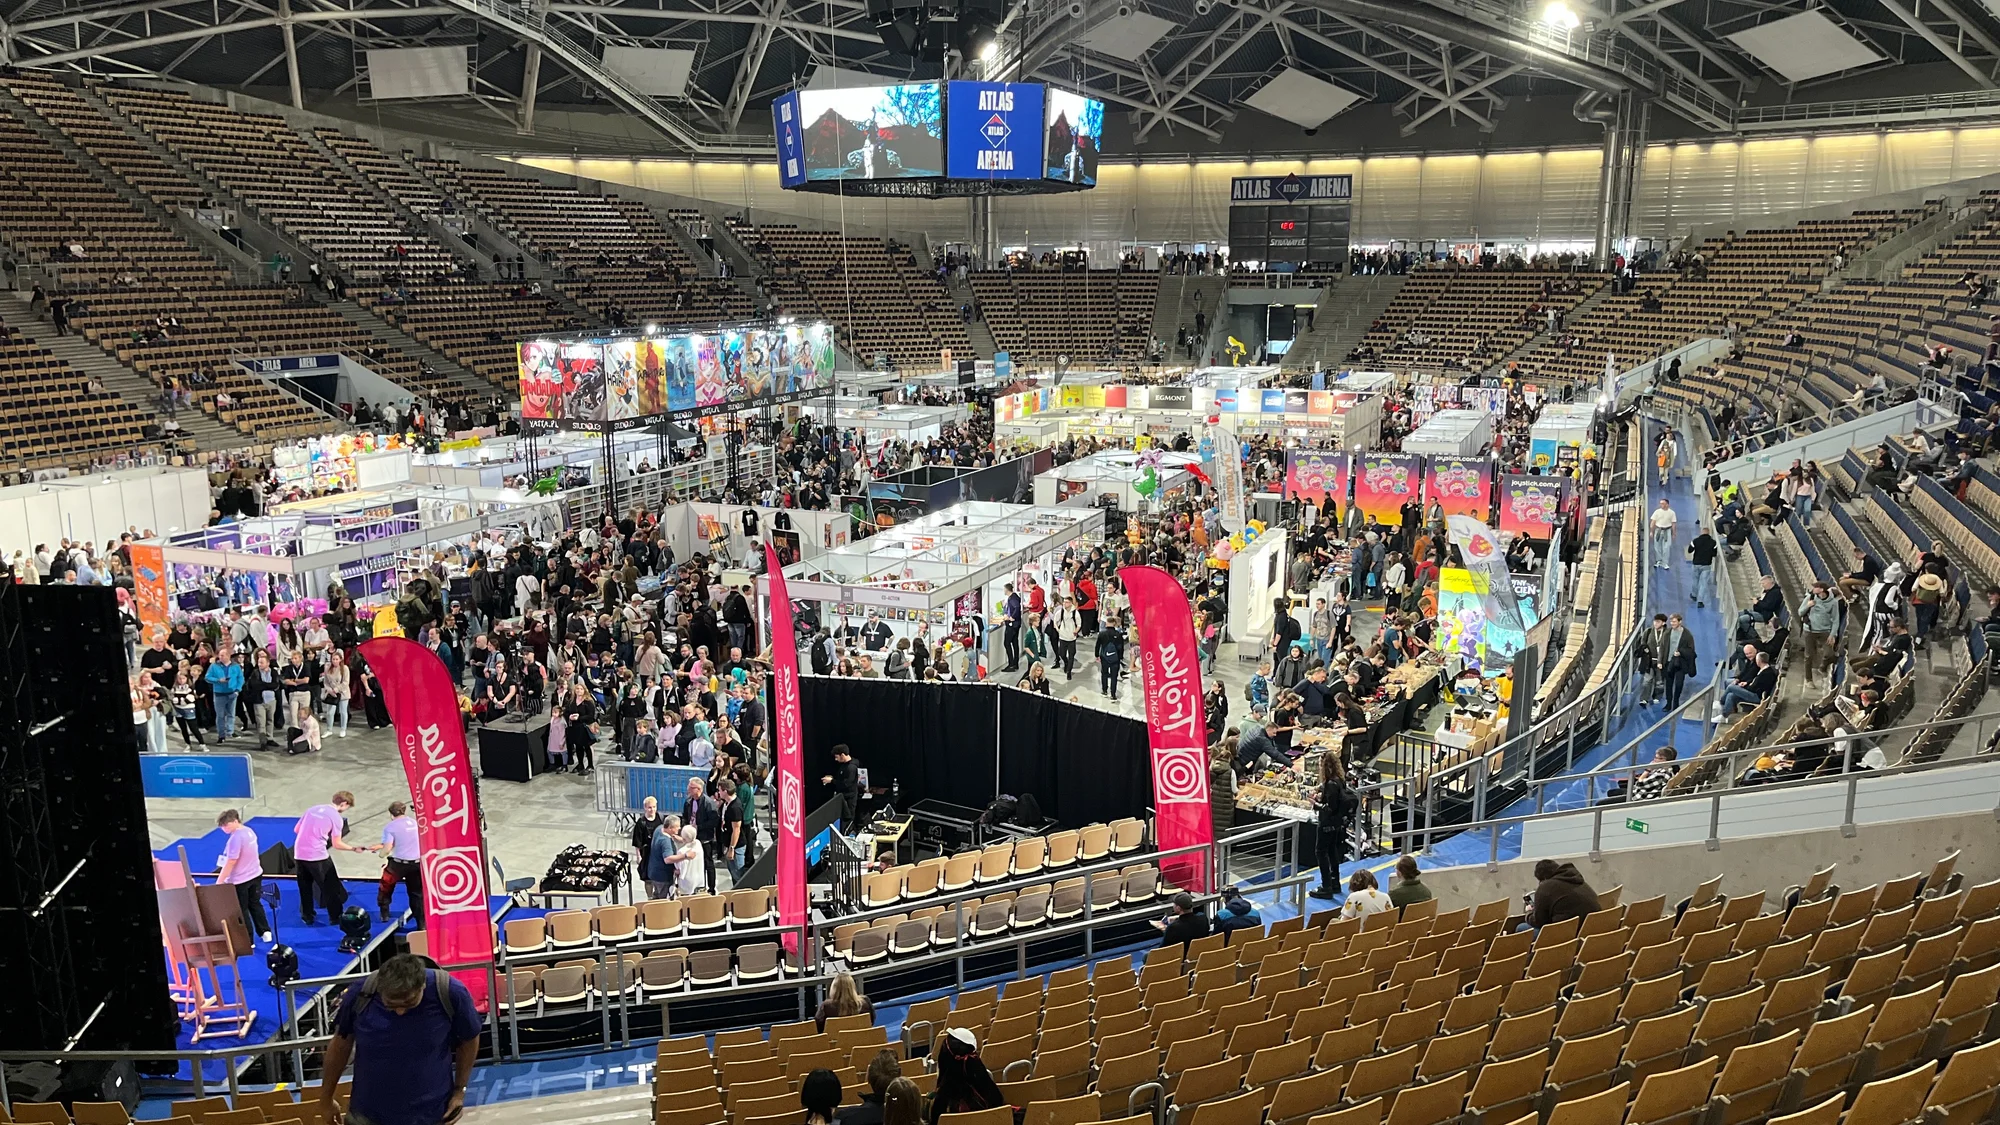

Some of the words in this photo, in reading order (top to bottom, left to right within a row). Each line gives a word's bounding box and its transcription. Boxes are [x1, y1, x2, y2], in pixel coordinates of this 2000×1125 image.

[978, 90, 1014, 112] ATLAS
[987, 126, 1004, 136] ATLAS
[976, 150, 1014, 170] ARENA
[1233, 179, 1271, 199] ATLAS
[1310, 178, 1350, 197] ARENA
[1283, 184, 1300, 193] ATLAS
[262, 359, 282, 371] ATLAS
[299, 356, 318, 368] ARENA
[1155, 394, 1187, 402] EGMONT
[1365, 452, 1412, 460] joystick.com.pl
[1435, 455, 1484, 463] joystick.com.pl
[1511, 480, 1560, 488] joystick.com.pl
